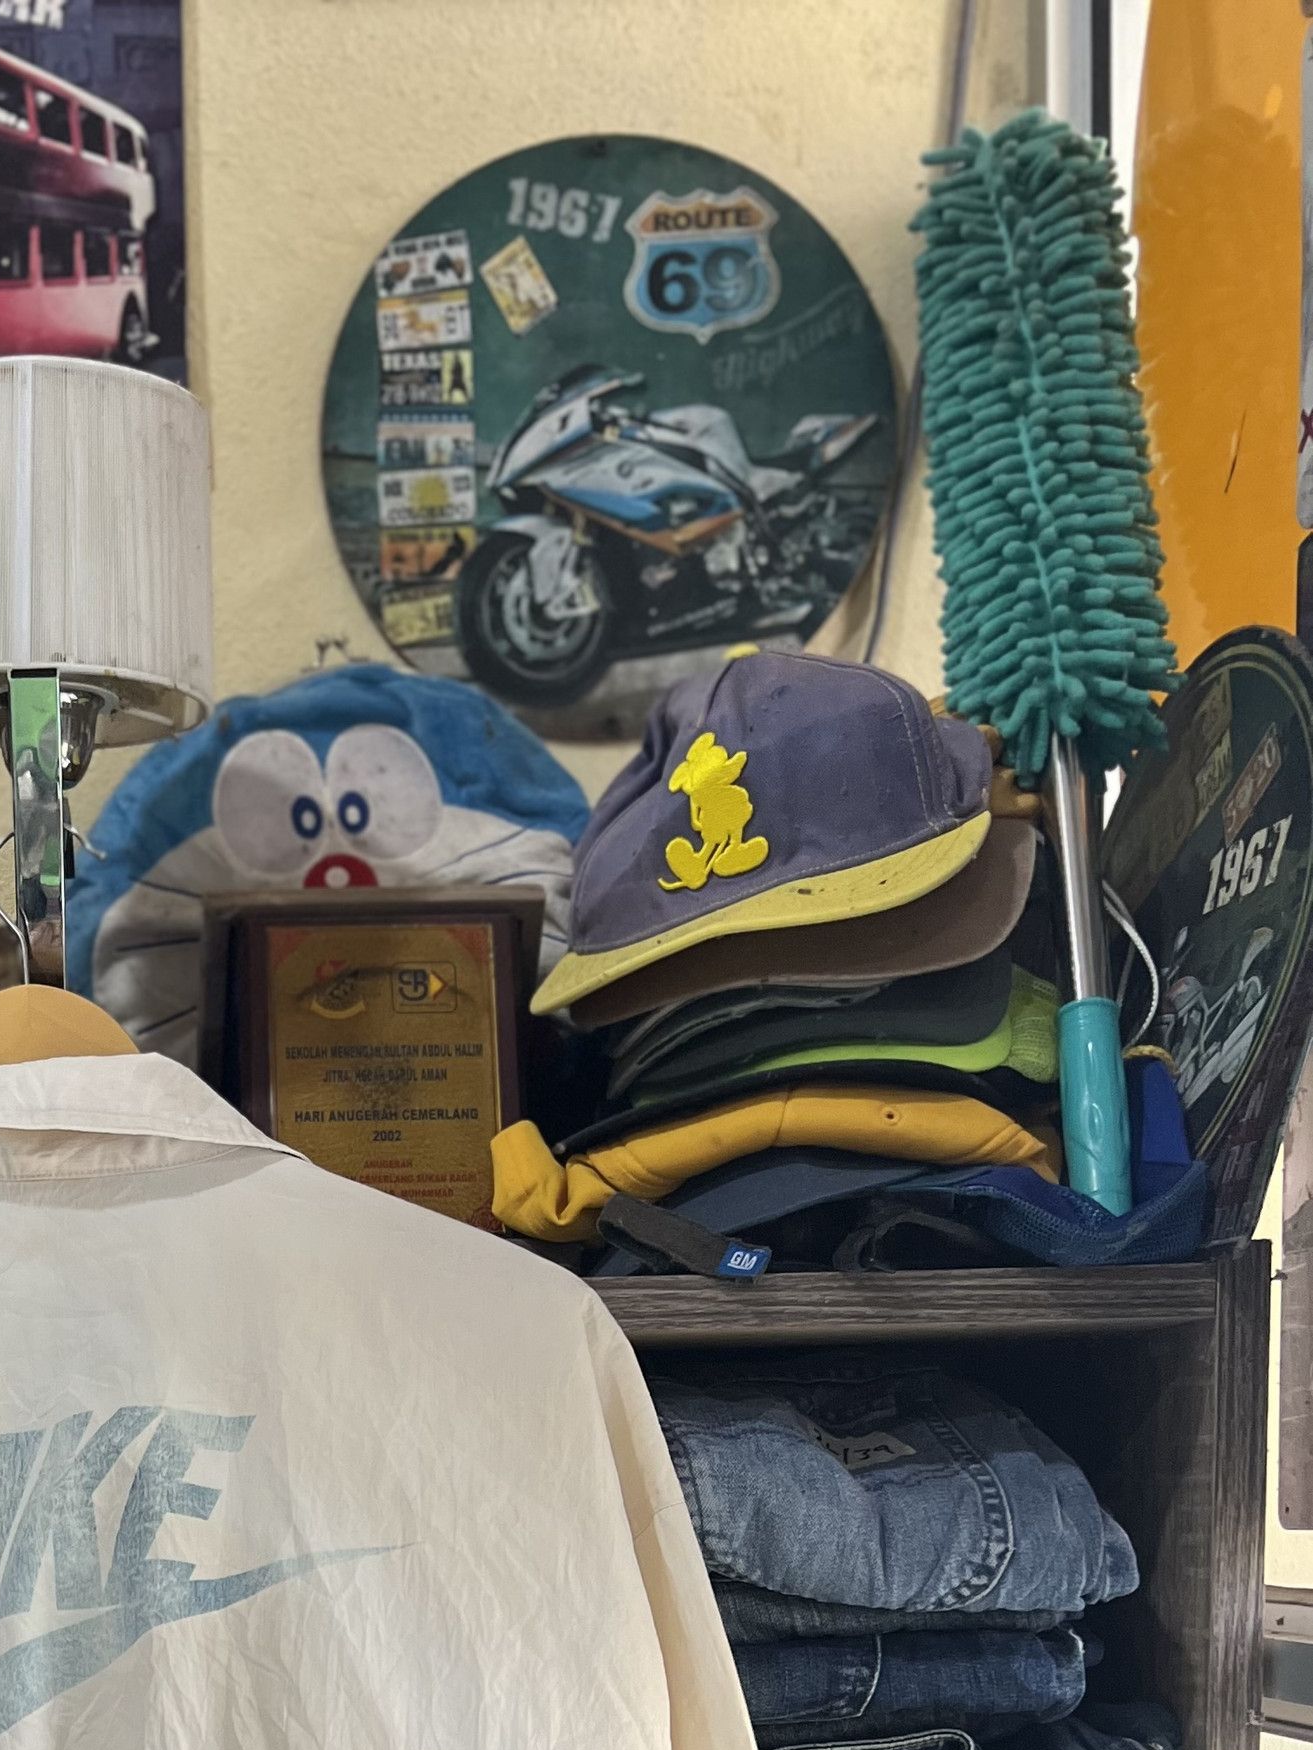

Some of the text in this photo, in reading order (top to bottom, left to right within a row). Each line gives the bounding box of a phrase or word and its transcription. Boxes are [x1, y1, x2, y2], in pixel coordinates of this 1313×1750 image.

[507, 177, 622, 243] 1967
[653, 206, 752, 232] ROUTE
[1203, 814, 1293, 915] 1967
[421, 1068, 448, 1081] AMAN
[294, 1107, 479, 1123] HARI ANUGERAH CEMERLANG
[372, 1130, 402, 1142] 2002
[730, 1251, 757, 1270] GM
